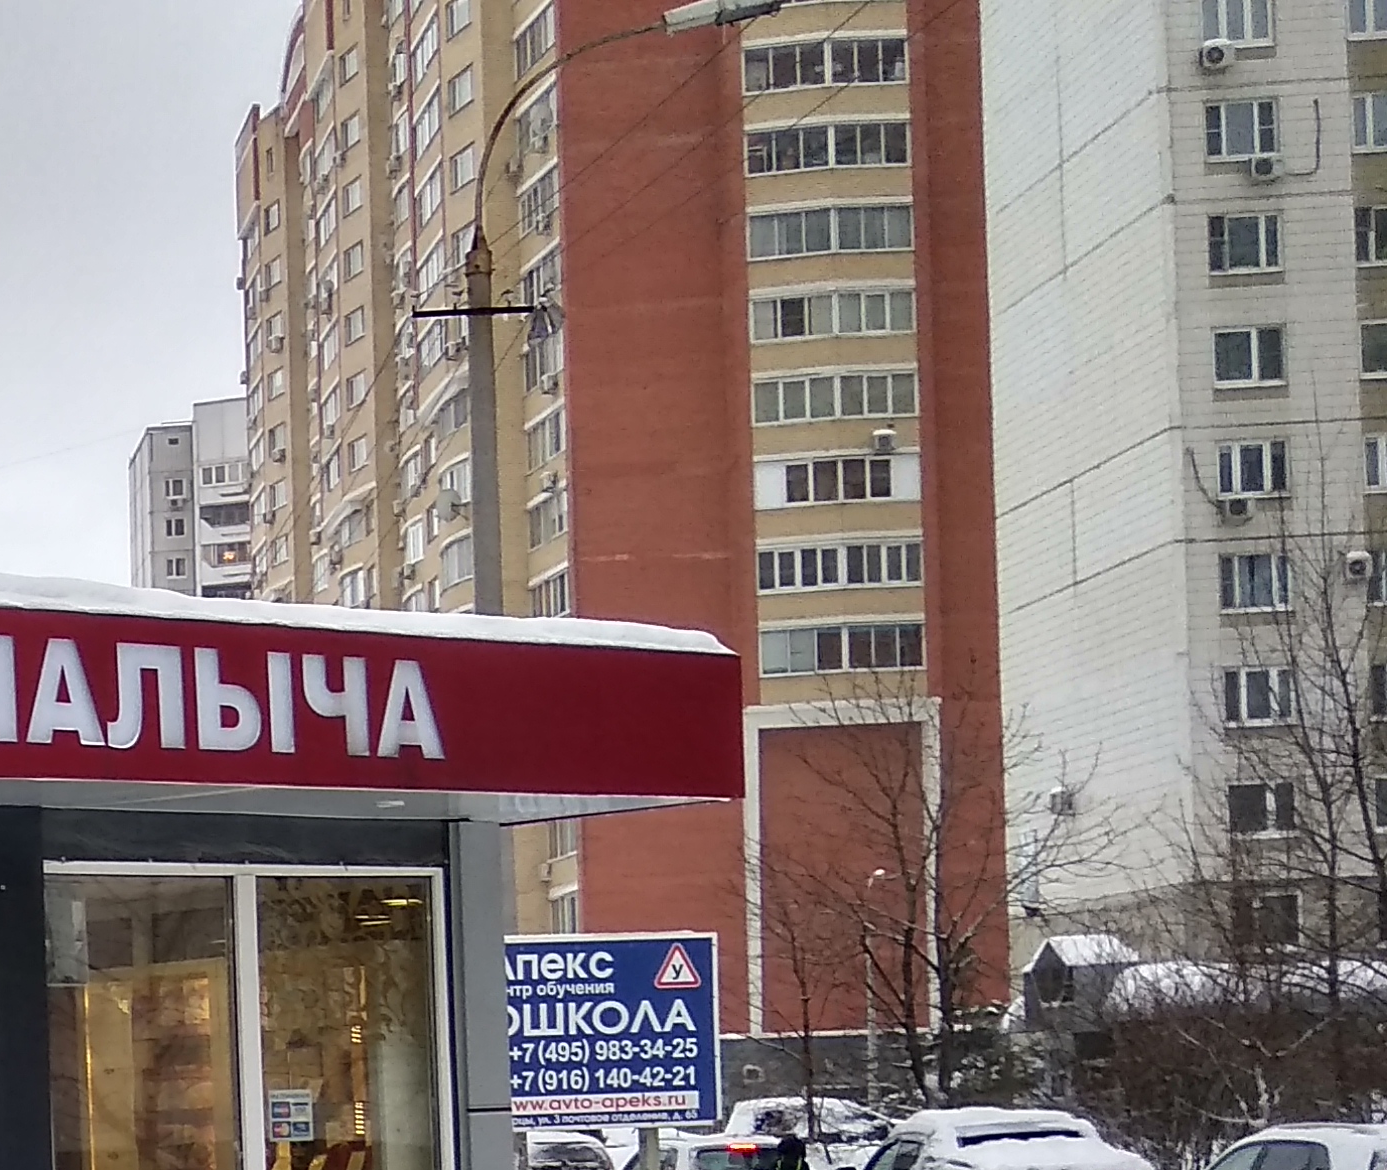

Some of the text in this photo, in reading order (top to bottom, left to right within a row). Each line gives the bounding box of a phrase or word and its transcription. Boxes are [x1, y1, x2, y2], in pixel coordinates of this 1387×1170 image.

[536, 982, 615, 999] обучения
[596, 1038, 698, 1061] 983-34-25
[595, 1066, 696, 1088] 140-42-21
[554, 1114, 560, 1124] 3
